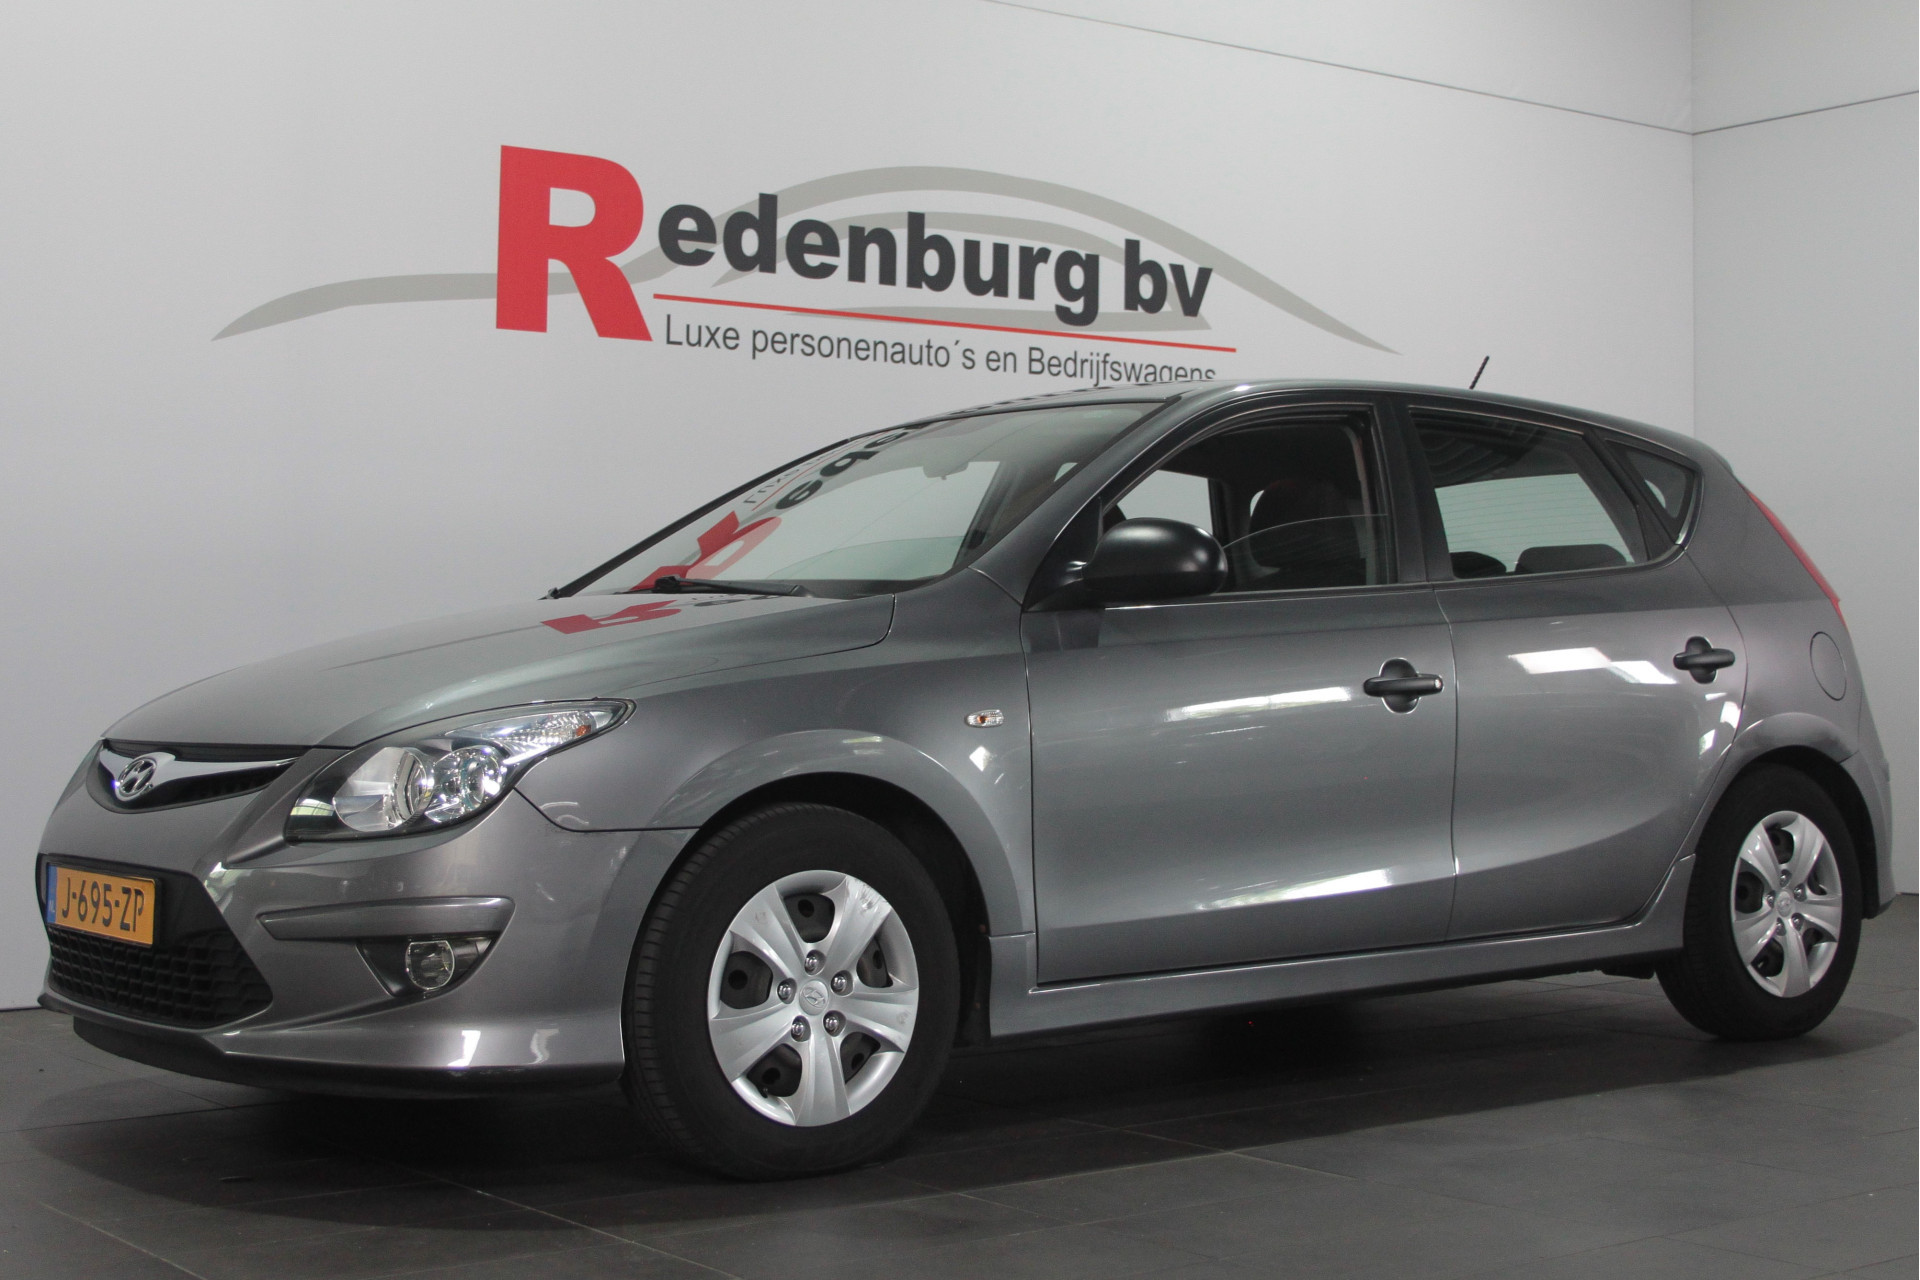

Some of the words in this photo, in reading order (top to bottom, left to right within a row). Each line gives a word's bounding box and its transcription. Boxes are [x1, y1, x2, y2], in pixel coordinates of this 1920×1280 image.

[495, 145, 1101, 342] Redenburg
[1125, 239, 1213, 318] bv
[665, 314, 741, 352] Luxe
[985, 349, 1018, 374] en
[1028, 346, 1217, 388] Bedrijfswagens
[62, 877, 145, 932] J-695-ZP
